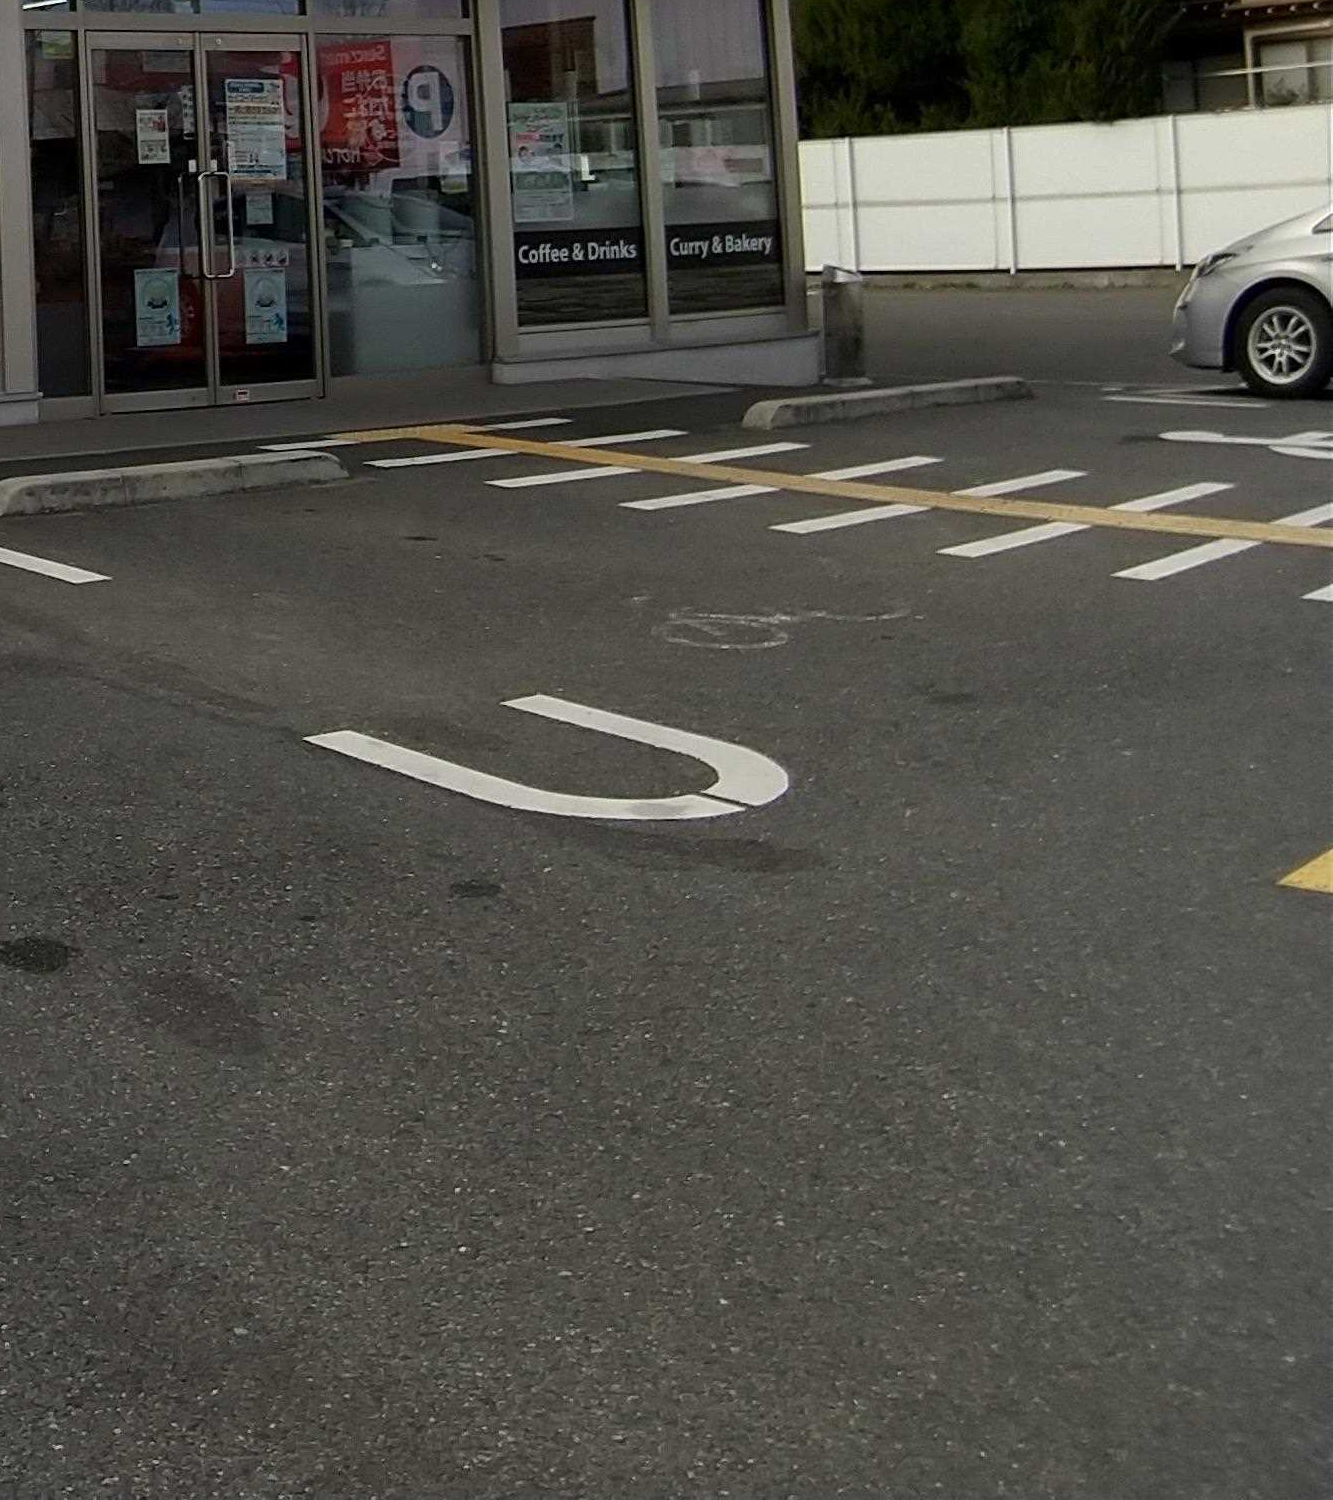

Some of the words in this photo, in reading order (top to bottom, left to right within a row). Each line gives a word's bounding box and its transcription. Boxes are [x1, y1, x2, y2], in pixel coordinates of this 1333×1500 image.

[518, 243, 568, 264] Coffee
[572, 243, 584, 261] &
[587, 240, 637, 261] Drinks
[669, 237, 709, 259] Curry
[711, 235, 723, 254] &
[724, 233, 773, 255] Bakery
